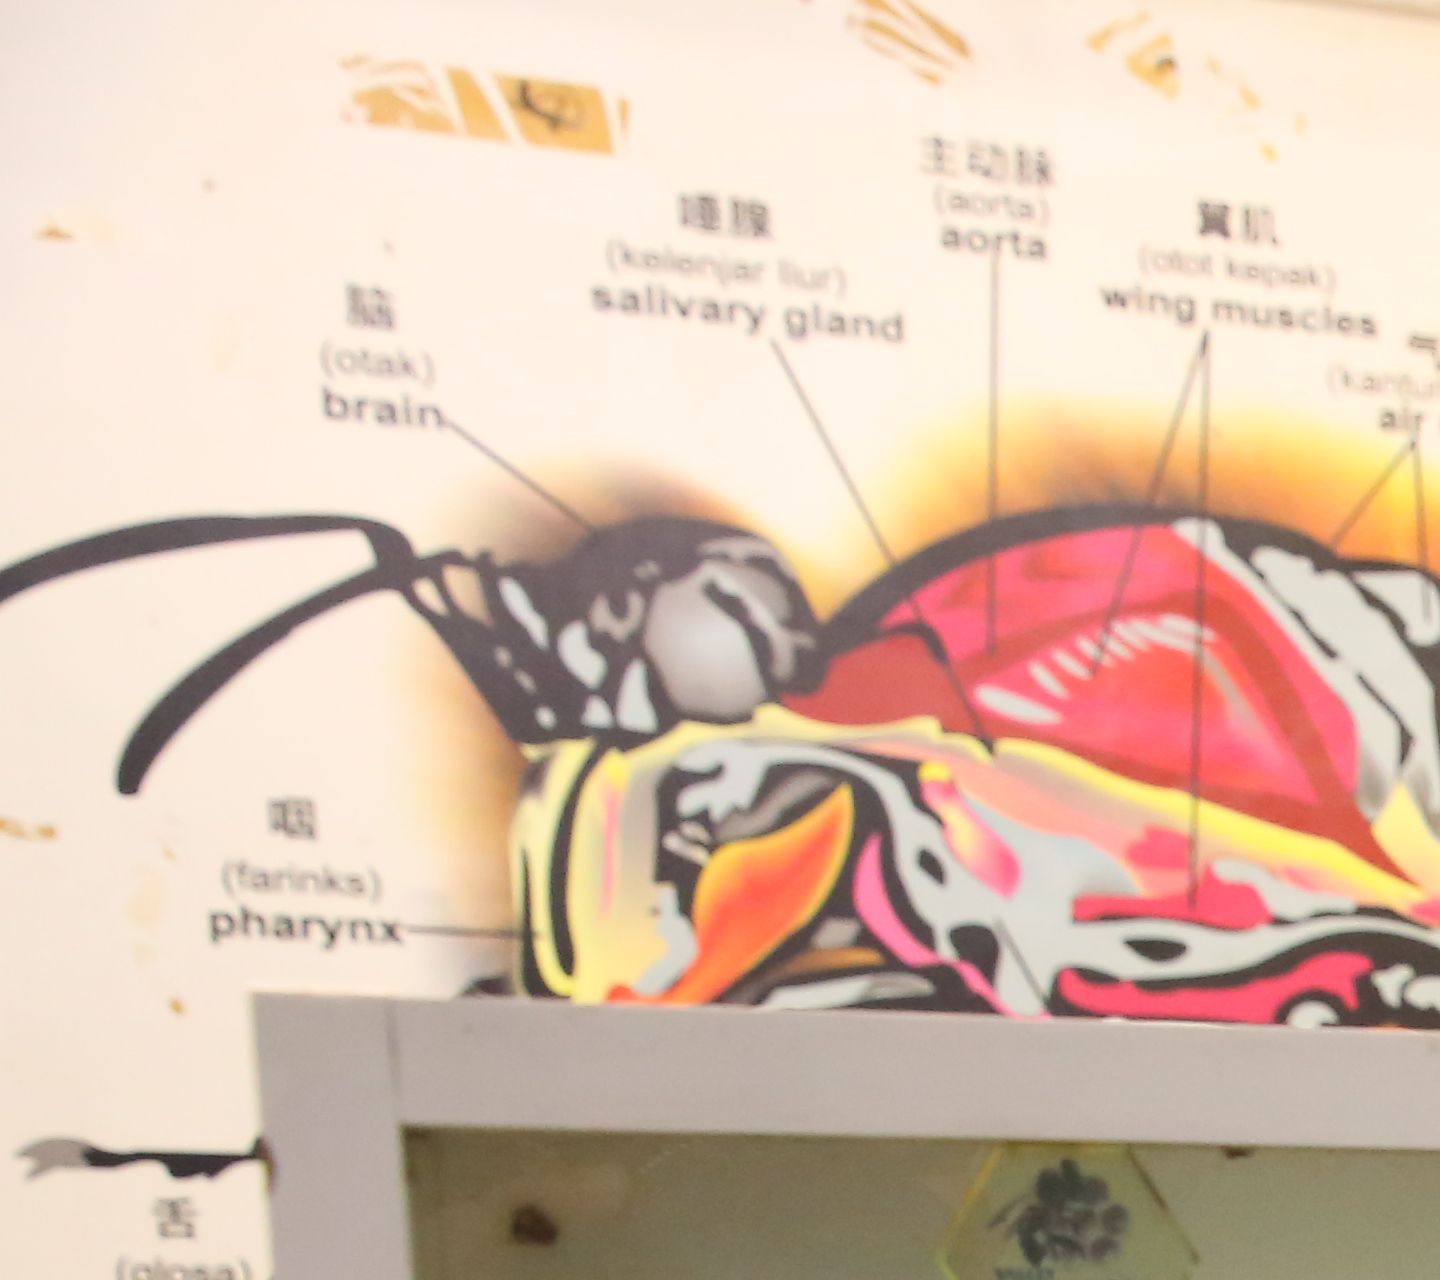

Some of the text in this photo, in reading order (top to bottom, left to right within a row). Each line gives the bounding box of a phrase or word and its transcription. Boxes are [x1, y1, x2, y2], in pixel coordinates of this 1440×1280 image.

[940, 222, 1048, 261] aorta
[590, 279, 906, 345] salivary gland
[1100, 284, 1378, 340] wing muscles
[319, 340, 436, 389] (otak)
[320, 386, 446, 428] brain
[1378, 402, 1426, 436] air
[221, 857, 385, 905] (farinks)
[207, 903, 406, 953] pharynx
